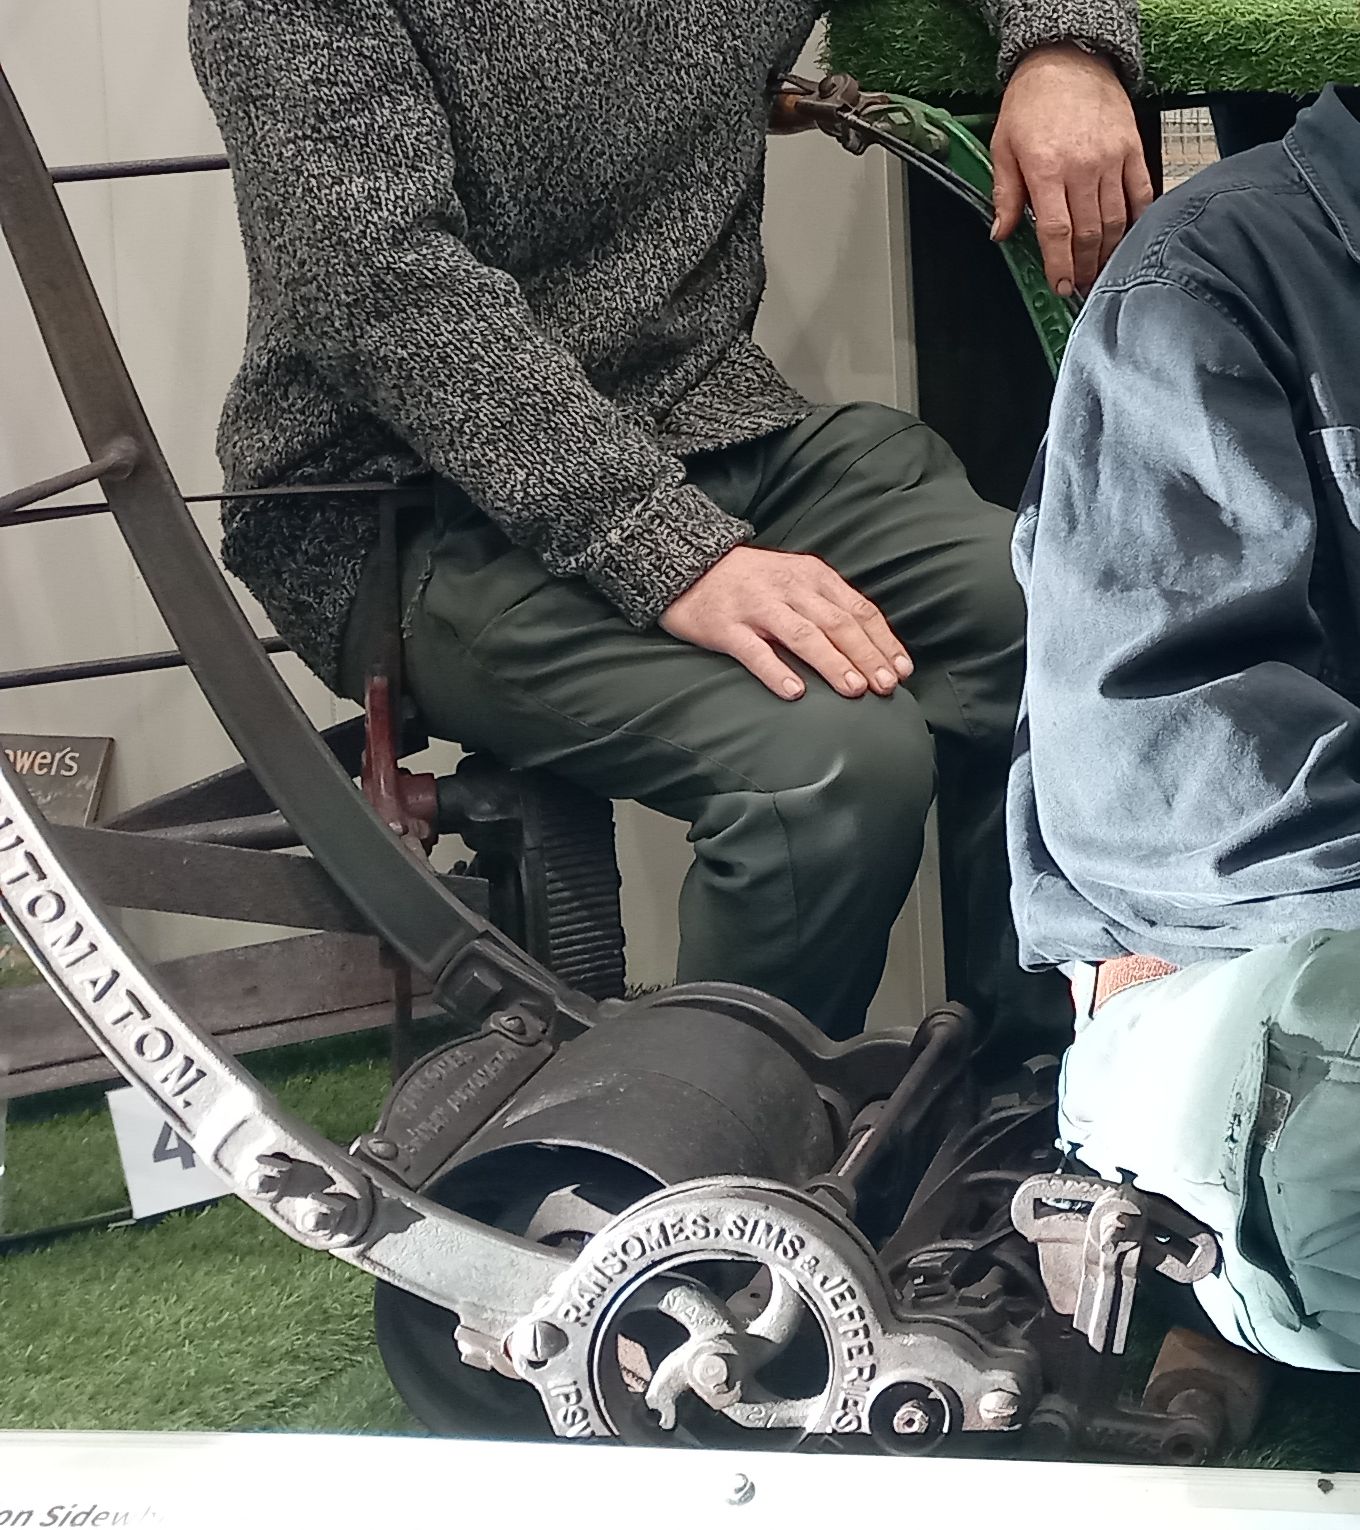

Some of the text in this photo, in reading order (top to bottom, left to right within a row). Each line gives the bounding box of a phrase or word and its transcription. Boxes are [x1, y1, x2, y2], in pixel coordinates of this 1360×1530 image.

[153, 1120, 197, 1171] 4
[723, 1214, 807, 1261] SIMS
[799, 1255, 821, 1279] &
